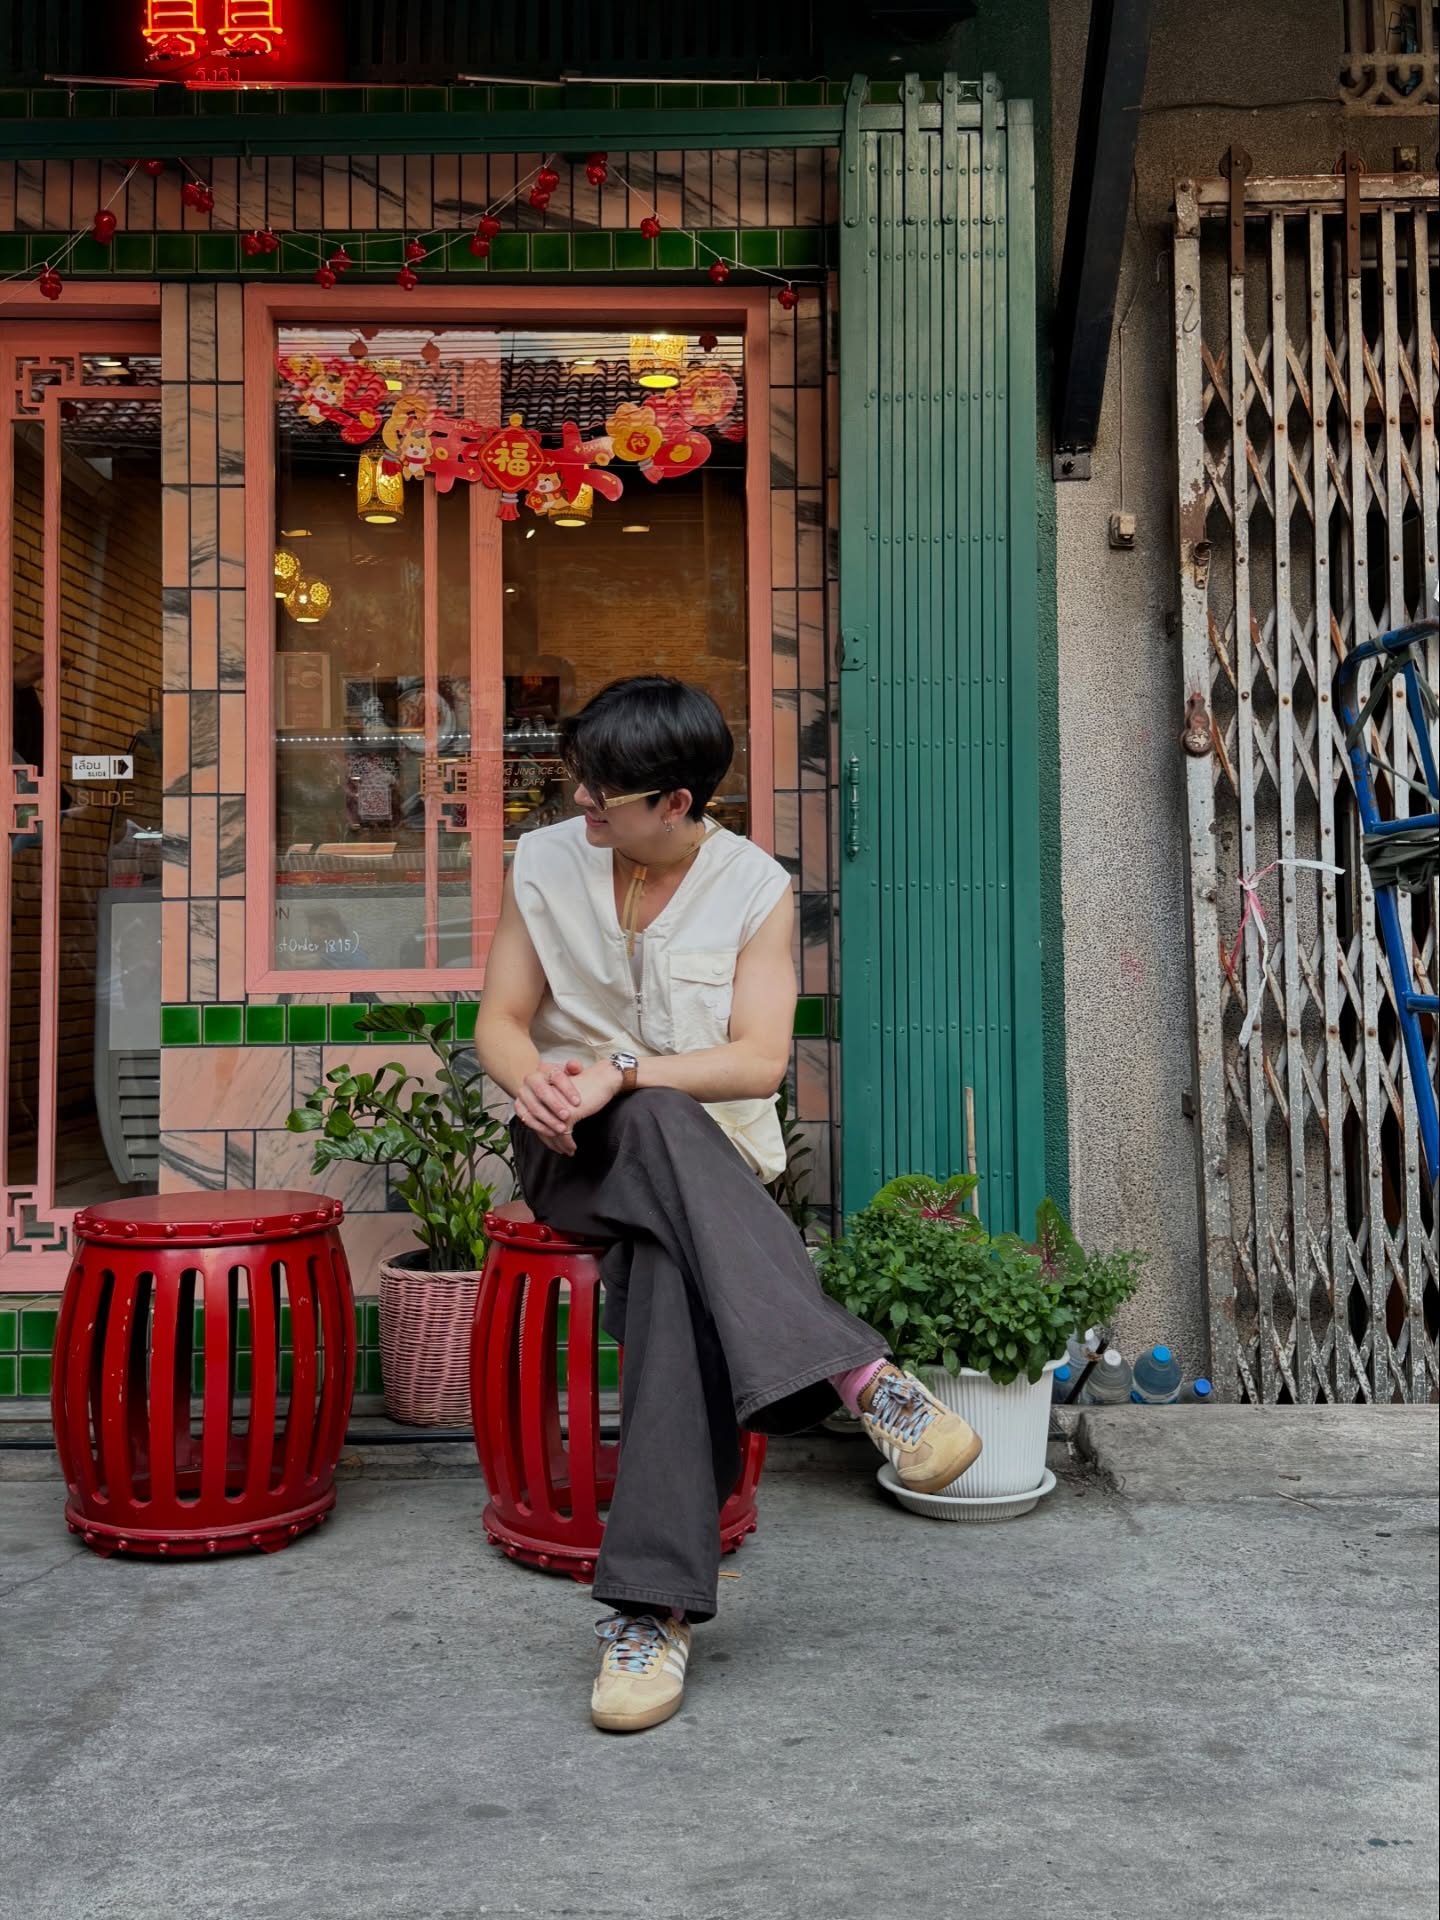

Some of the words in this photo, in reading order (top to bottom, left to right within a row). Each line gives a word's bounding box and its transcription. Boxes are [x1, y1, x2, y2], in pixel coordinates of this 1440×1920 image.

[492, 440, 531, 477] 福
[514, 766, 535, 776] JING
[77, 790, 135, 806] SLIDE
